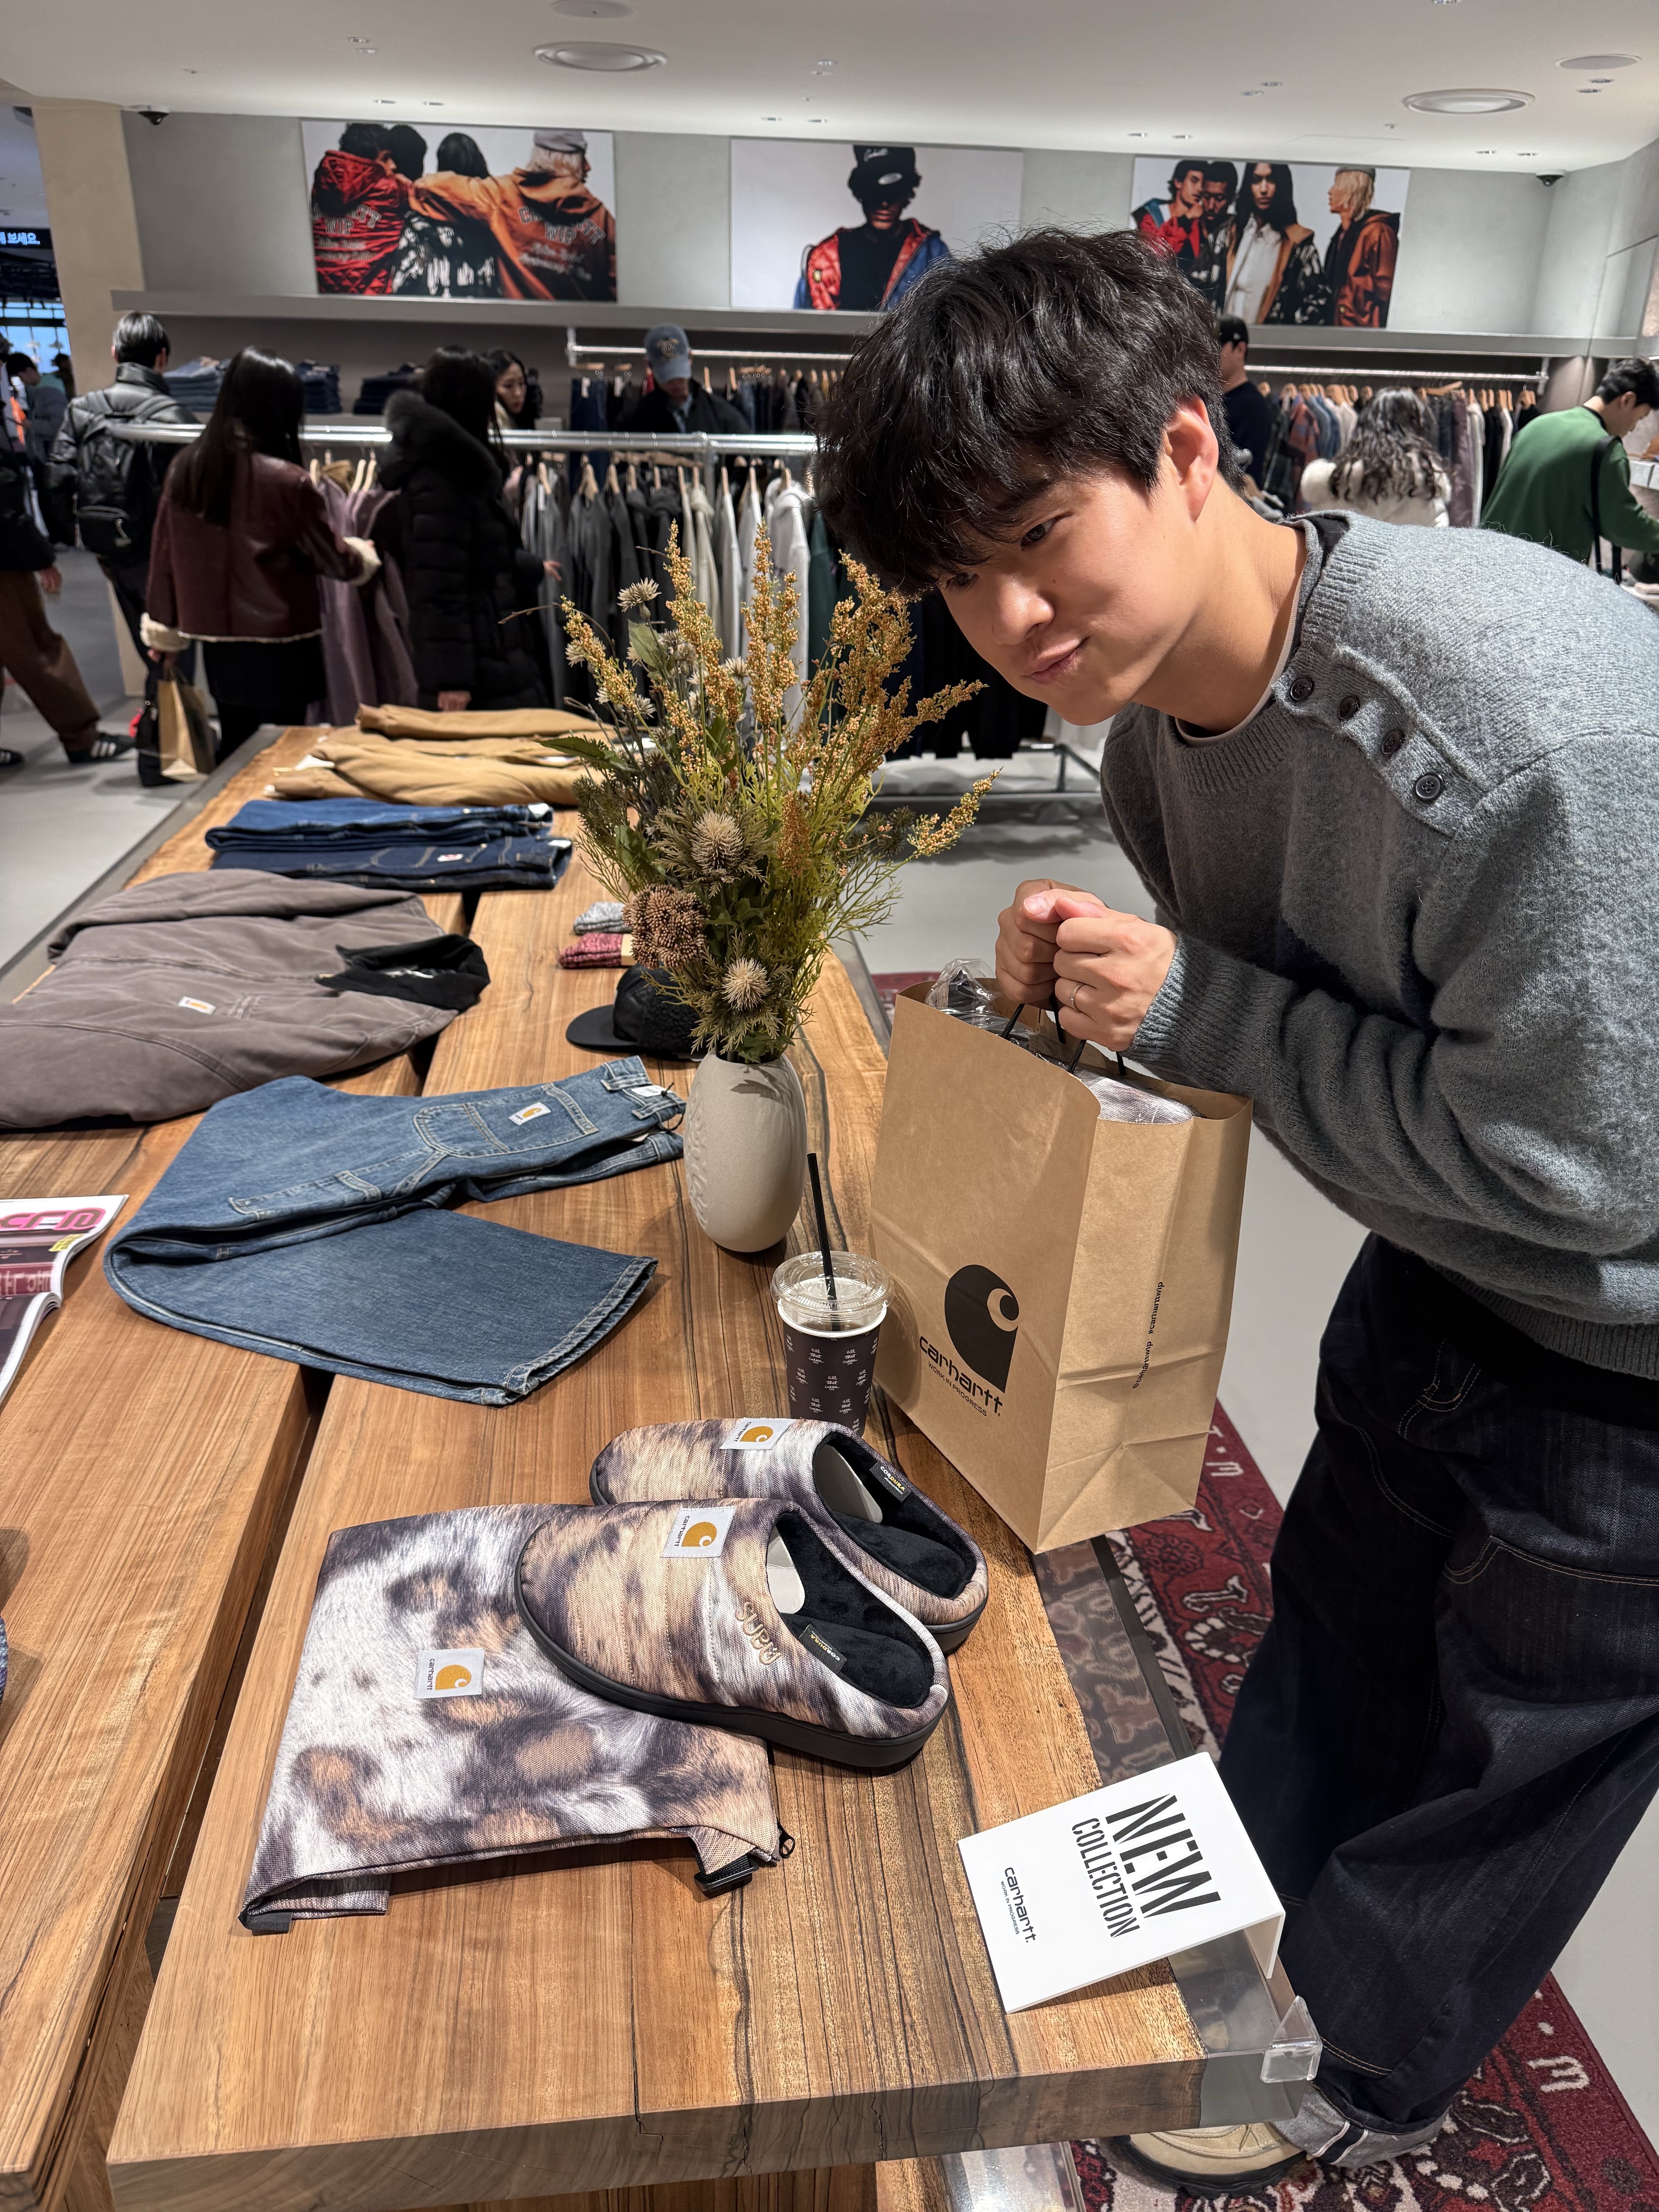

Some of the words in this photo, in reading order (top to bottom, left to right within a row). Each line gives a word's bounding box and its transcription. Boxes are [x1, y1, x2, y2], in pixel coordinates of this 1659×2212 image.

[928, 1361, 945, 1381] WORK
[946, 1378, 951, 1386] IN
[953, 1384, 987, 1416] PROGRESS
[674, 1516, 690, 1547] carhartt
[427, 1658, 435, 1690] carhartt
[1105, 1793, 1221, 1918] NEW
[1072, 1818, 1140, 1938] COLLECTION
[1008, 1904, 1020, 1935] PROGRESS
